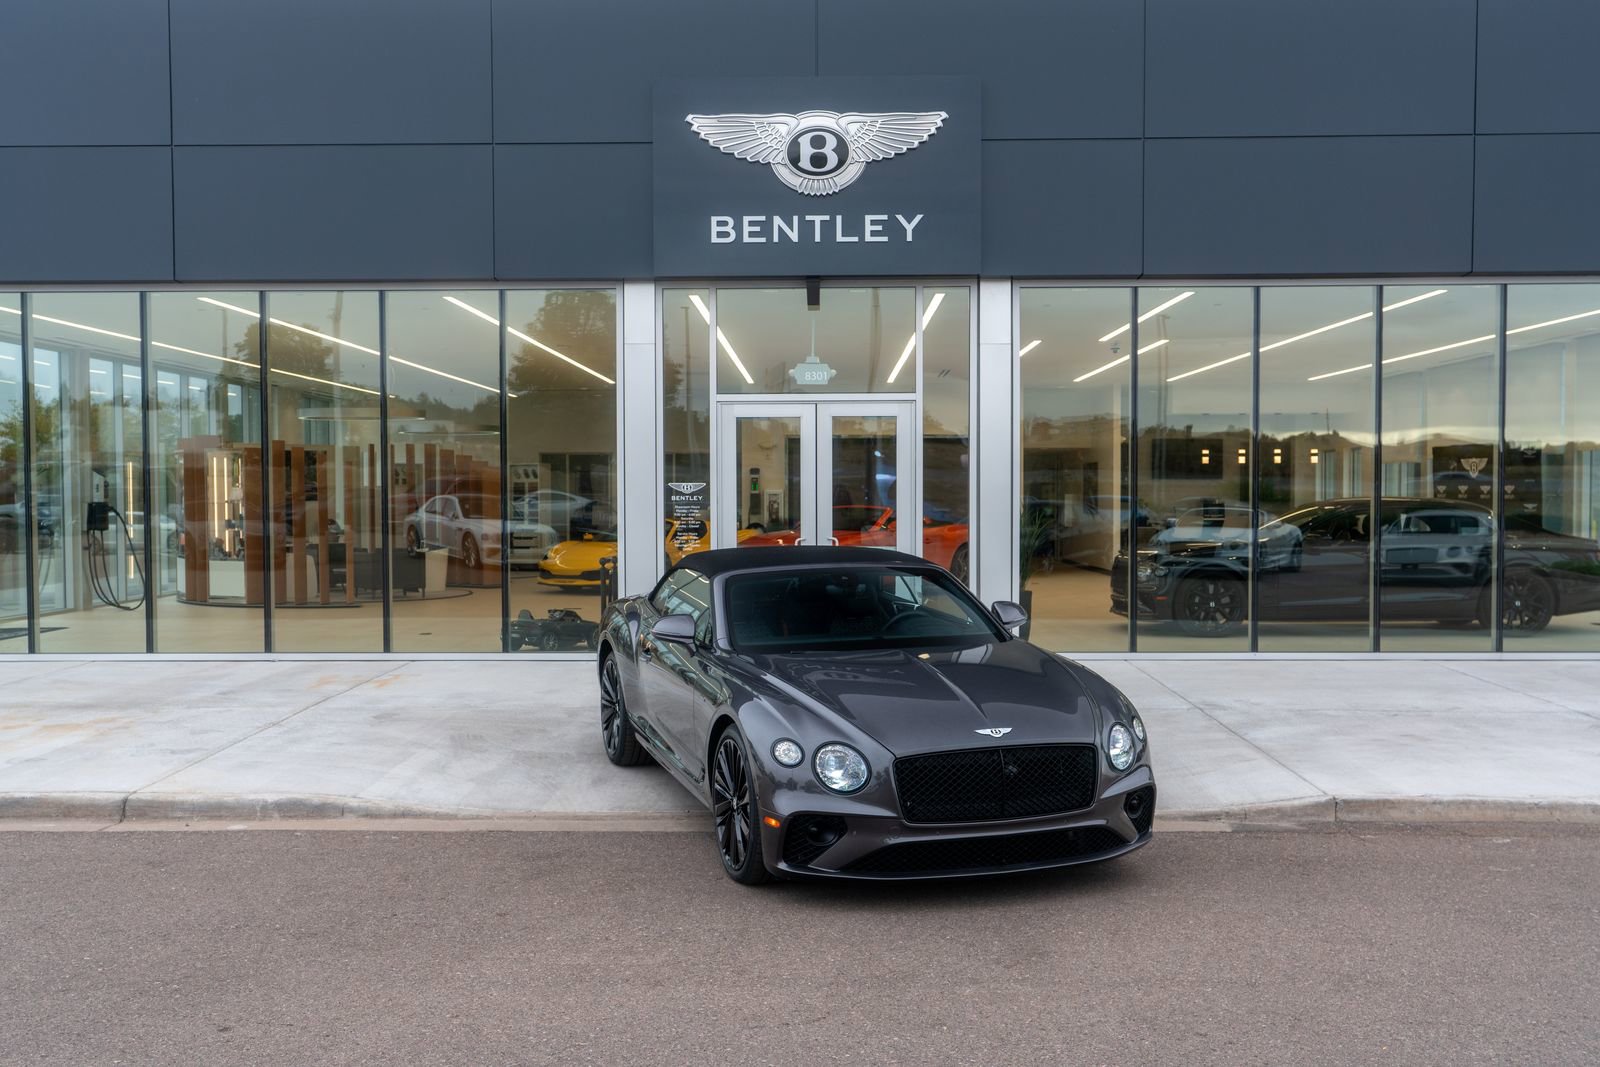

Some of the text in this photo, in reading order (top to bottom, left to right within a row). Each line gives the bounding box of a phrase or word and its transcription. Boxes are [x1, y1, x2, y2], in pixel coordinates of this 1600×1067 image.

[798, 132, 838, 172] B
[710, 214, 924, 243] BENTLEY
[805, 371, 827, 381] 8301
